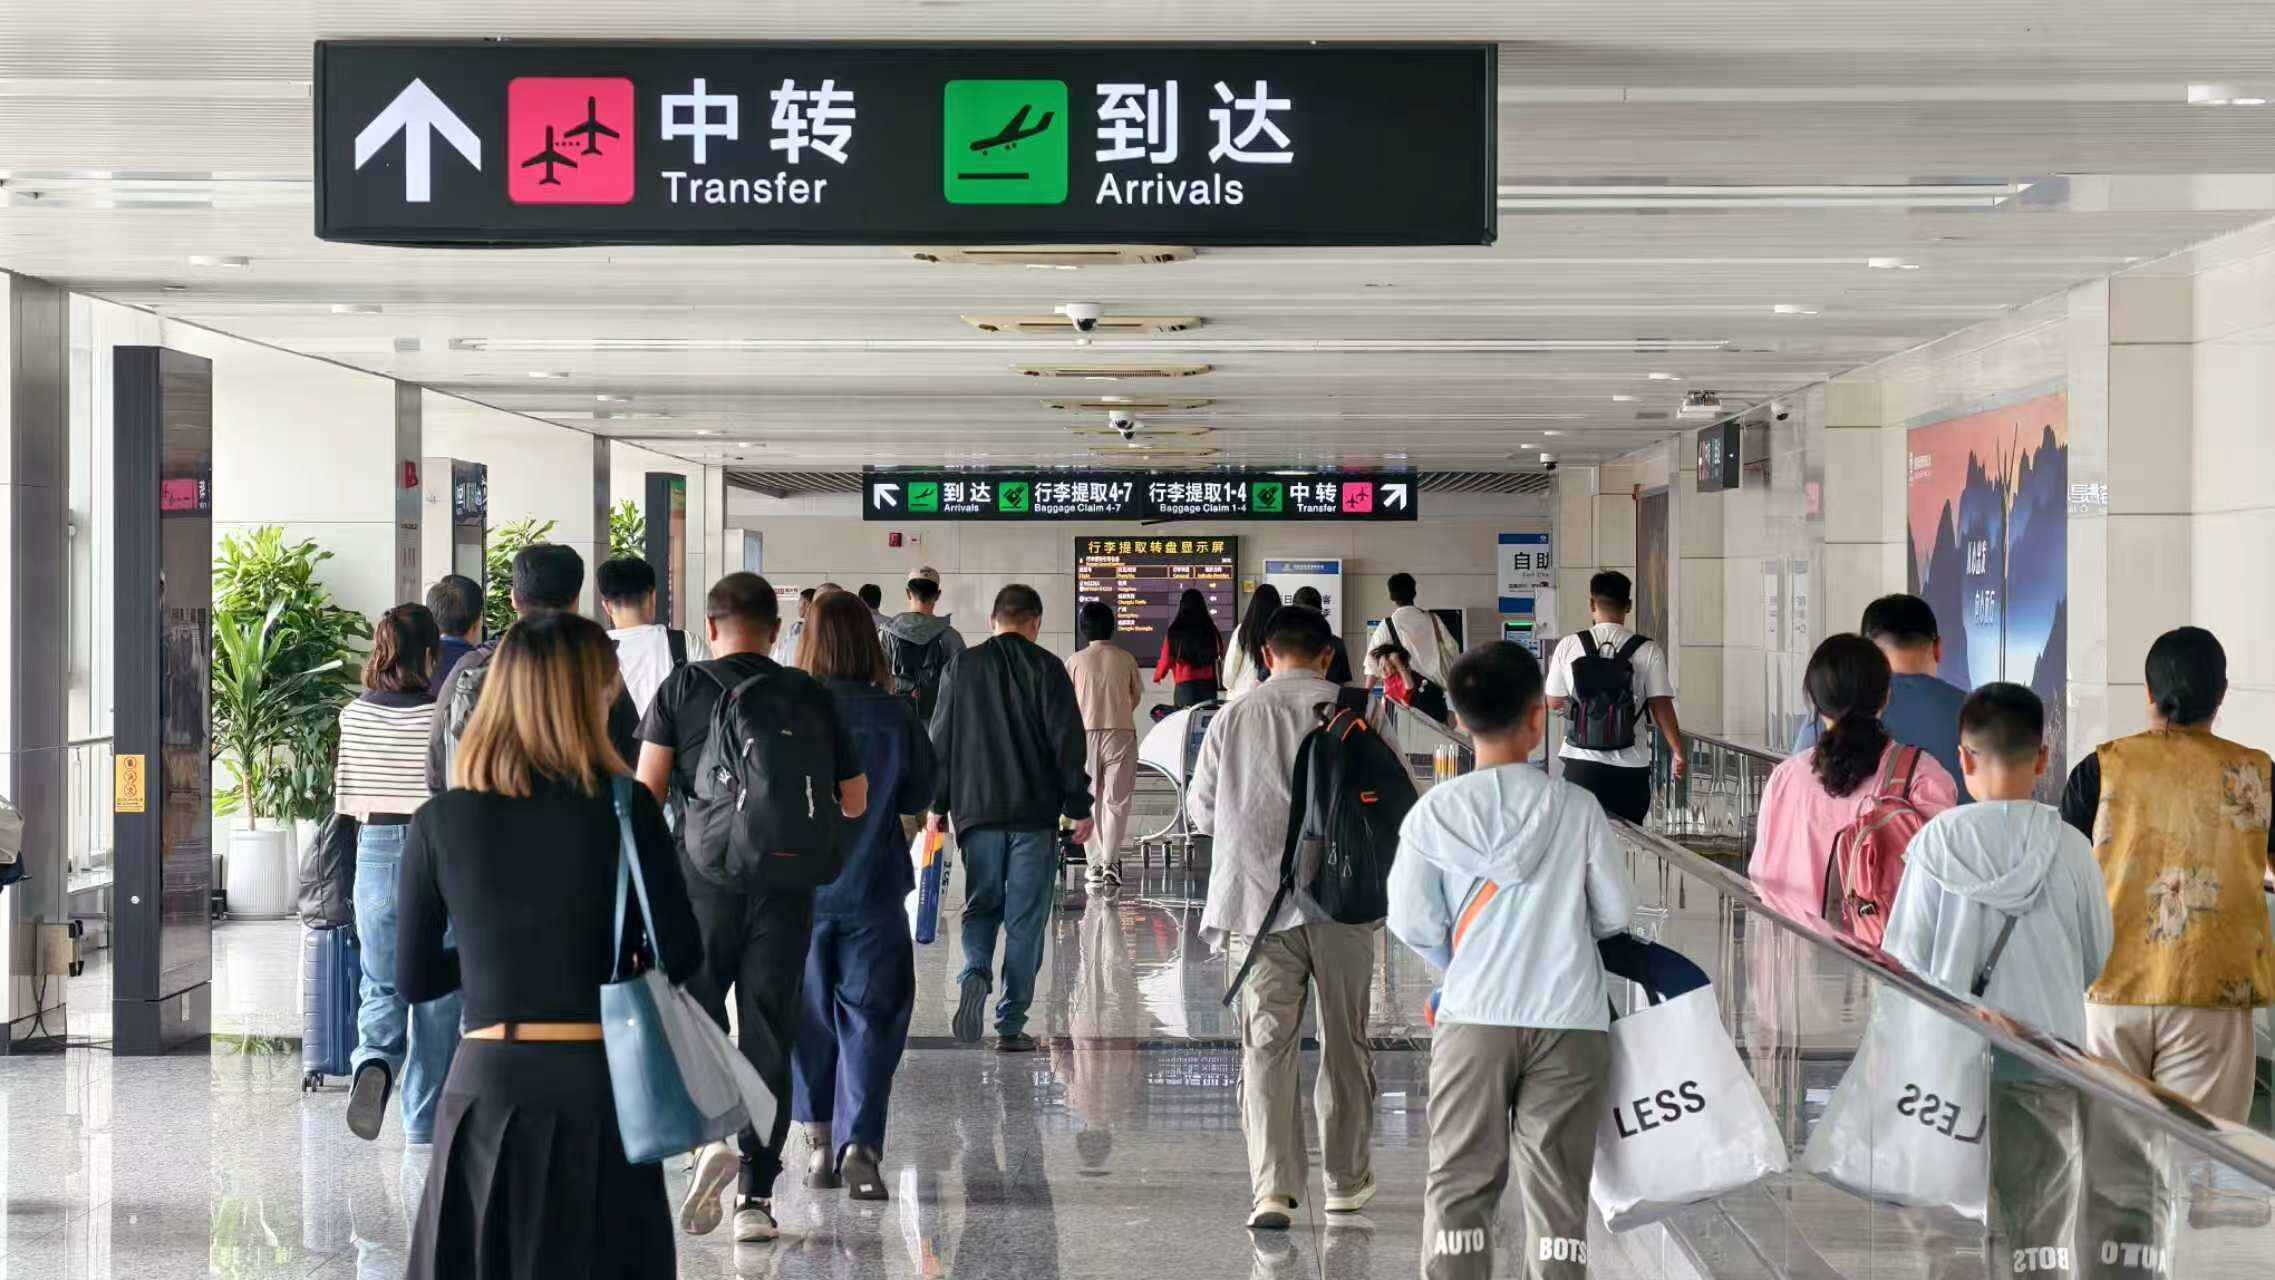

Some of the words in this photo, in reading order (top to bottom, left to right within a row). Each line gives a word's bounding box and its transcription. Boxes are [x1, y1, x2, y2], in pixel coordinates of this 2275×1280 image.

[660, 77, 856, 164] 中转
[1095, 79, 1295, 164] 到达
[661, 171, 828, 204] Transfer
[1096, 172, 1244, 205] Arrivals
[943, 481, 992, 503] 到达
[1034, 481, 1133, 503] 行李提取4-7
[1148, 481, 1247, 503] 行李提取1-4
[1289, 481, 1337, 503] 中转
[943, 503, 980, 513] Arrivals
[1034, 503, 1075, 514] Baggage
[1077, 503, 1104, 513] Claim
[1106, 503, 1122, 513] 4-7
[1159, 503, 1200, 514] Baggage
[1202, 503, 1229, 513] Claim
[1232, 503, 1247, 513] 1-4
[1297, 503, 1337, 513] Transfer
[1087, 541, 1224, 554] 行李提取转盘显示屏
[1613, 1080, 1706, 1139] LESS
[1435, 1228, 1485, 1256] AUTO
[1539, 1237, 1587, 1265] BOTS
